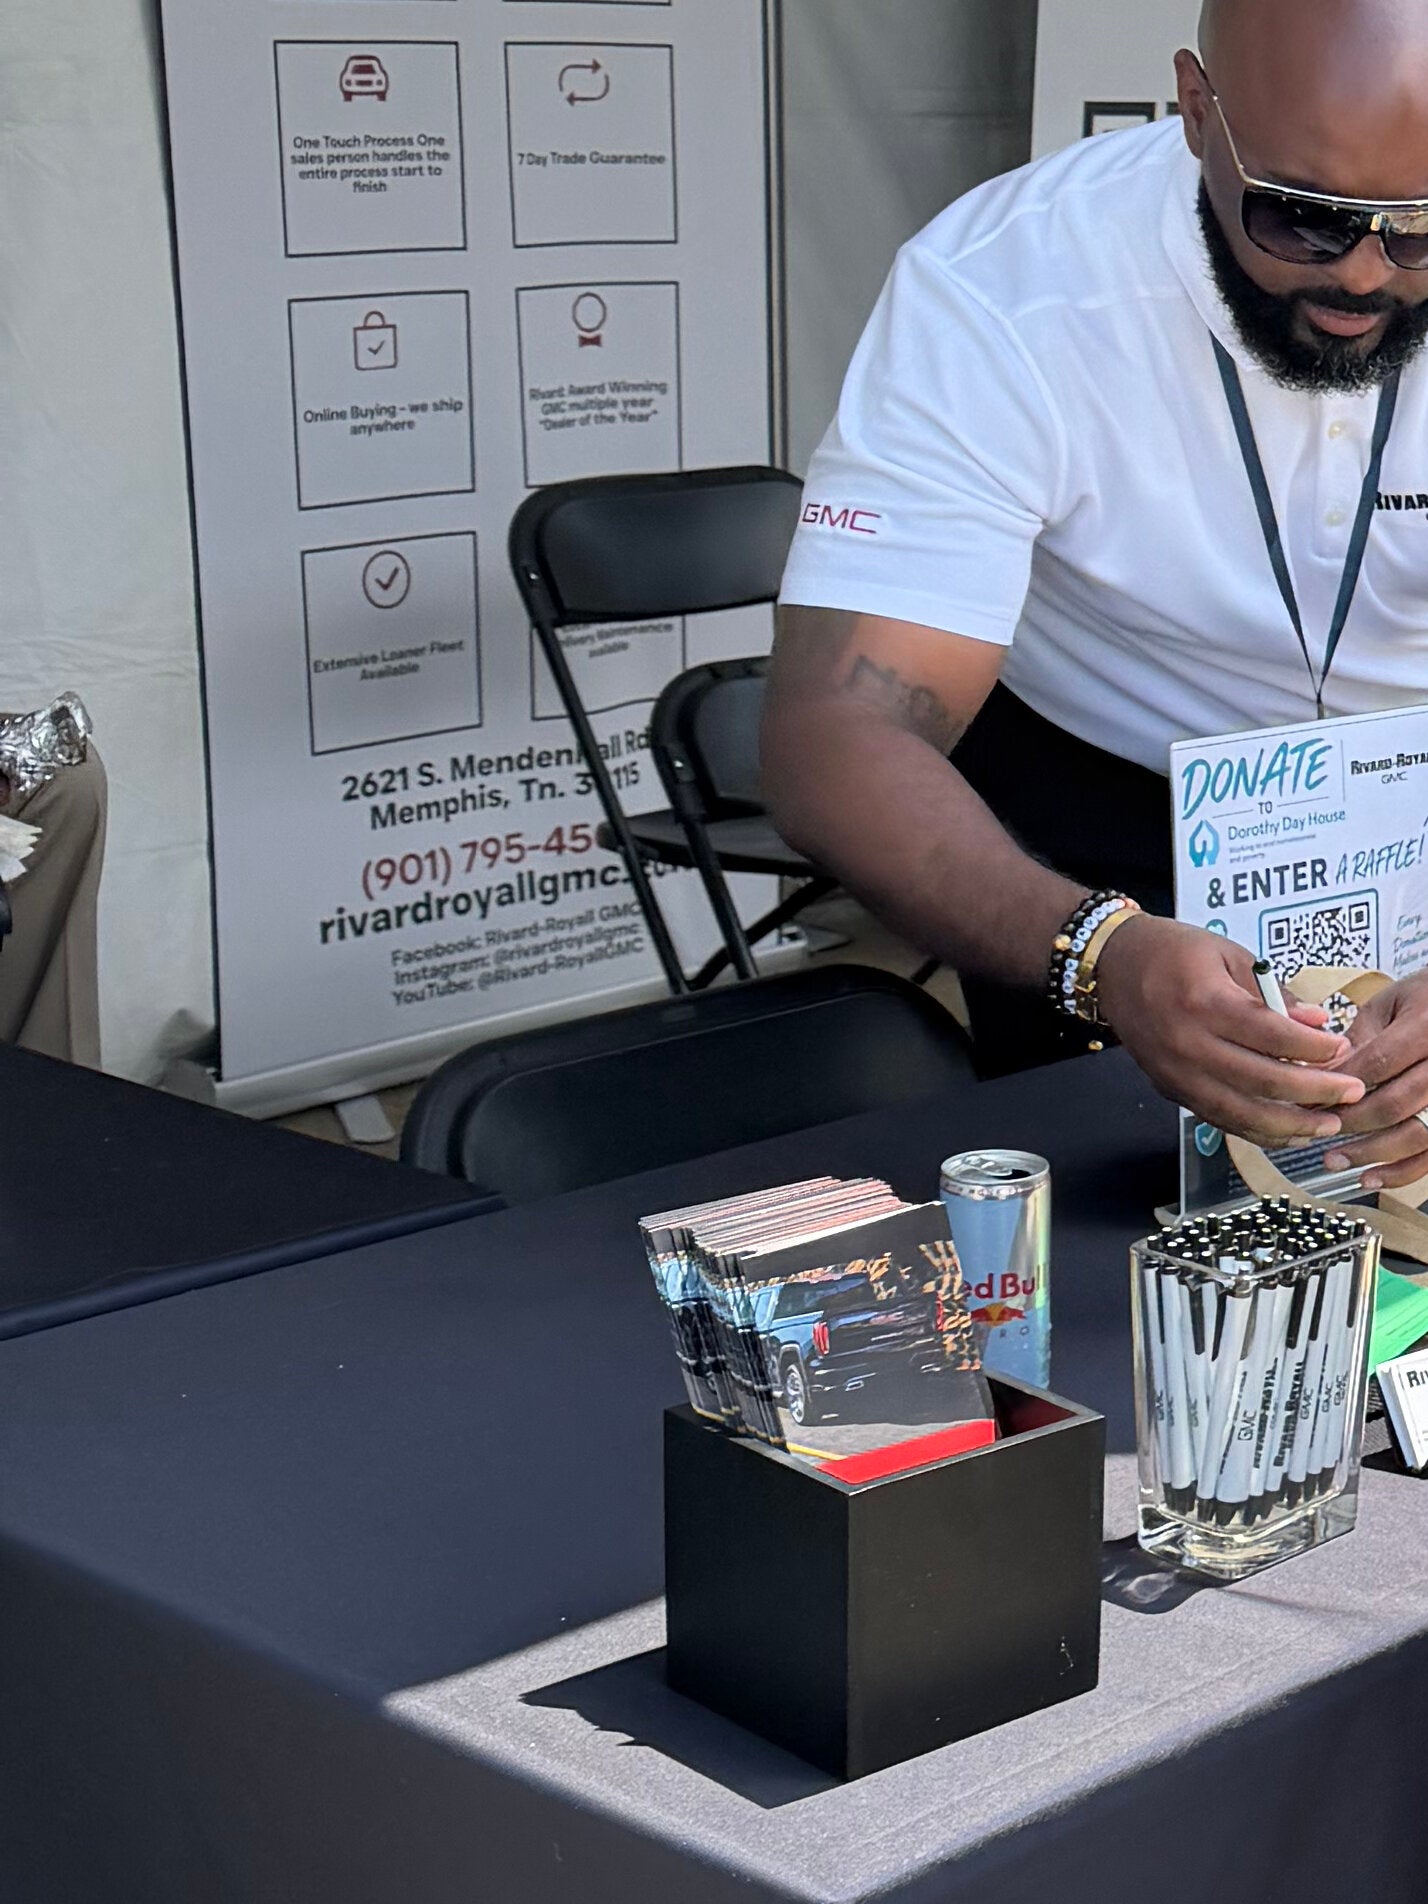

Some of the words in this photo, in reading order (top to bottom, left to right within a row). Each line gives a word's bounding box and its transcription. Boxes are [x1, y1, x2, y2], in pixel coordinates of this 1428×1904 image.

[293, 136, 320, 149] One
[323, 135, 361, 147] Touch
[364, 134, 414, 146] Process
[417, 133, 445, 146] One
[291, 152, 323, 165] sales
[326, 152, 369, 166] person
[372, 149, 423, 162] handles
[427, 149, 450, 161] the
[299, 167, 337, 180] entire
[340, 168, 388, 181] process
[391, 165, 424, 177] start
[428, 165, 442, 176] to
[517, 153, 525, 165] 7
[527, 153, 548, 168] Day
[550, 152, 587, 165] Trade
[589, 151, 666, 165] Guarantee
[353, 180, 387, 193] finish
[303, 407, 347, 423] Online
[351, 403, 397, 419] Buying
[409, 402, 429, 413] we
[432, 398, 463, 413] ship
[350, 419, 415, 437] anywhere
[802, 503, 881, 534] GMC
[313, 652, 379, 674] Extensive
[381, 645, 426, 663] Loaner
[429, 640, 464, 655] Fleet
[342, 767, 410, 801] 2621
[417, 762, 443, 787] S.
[1182, 738, 1333, 820] DONATE
[1381, 771, 1407, 784] GMC
[371, 785, 509, 830] Memphis,
[519, 778, 565, 802] Tn.
[576, 761, 640, 795] 3115
[1258, 801, 1273, 814] TO
[1228, 819, 1280, 841] Dorothy
[1282, 816, 1306, 832] Day
[1308, 809, 1346, 826] House
[362, 847, 451, 900] (901)
[1207, 877, 1226, 909] &
[1232, 858, 1328, 904] ENTER
[1336, 853, 1348, 885] A
[1351, 833, 1425, 881] RAFFLE!
[1301, 1388, 1313, 1420] GMC
[1237, 1409, 1257, 1441] GMC
